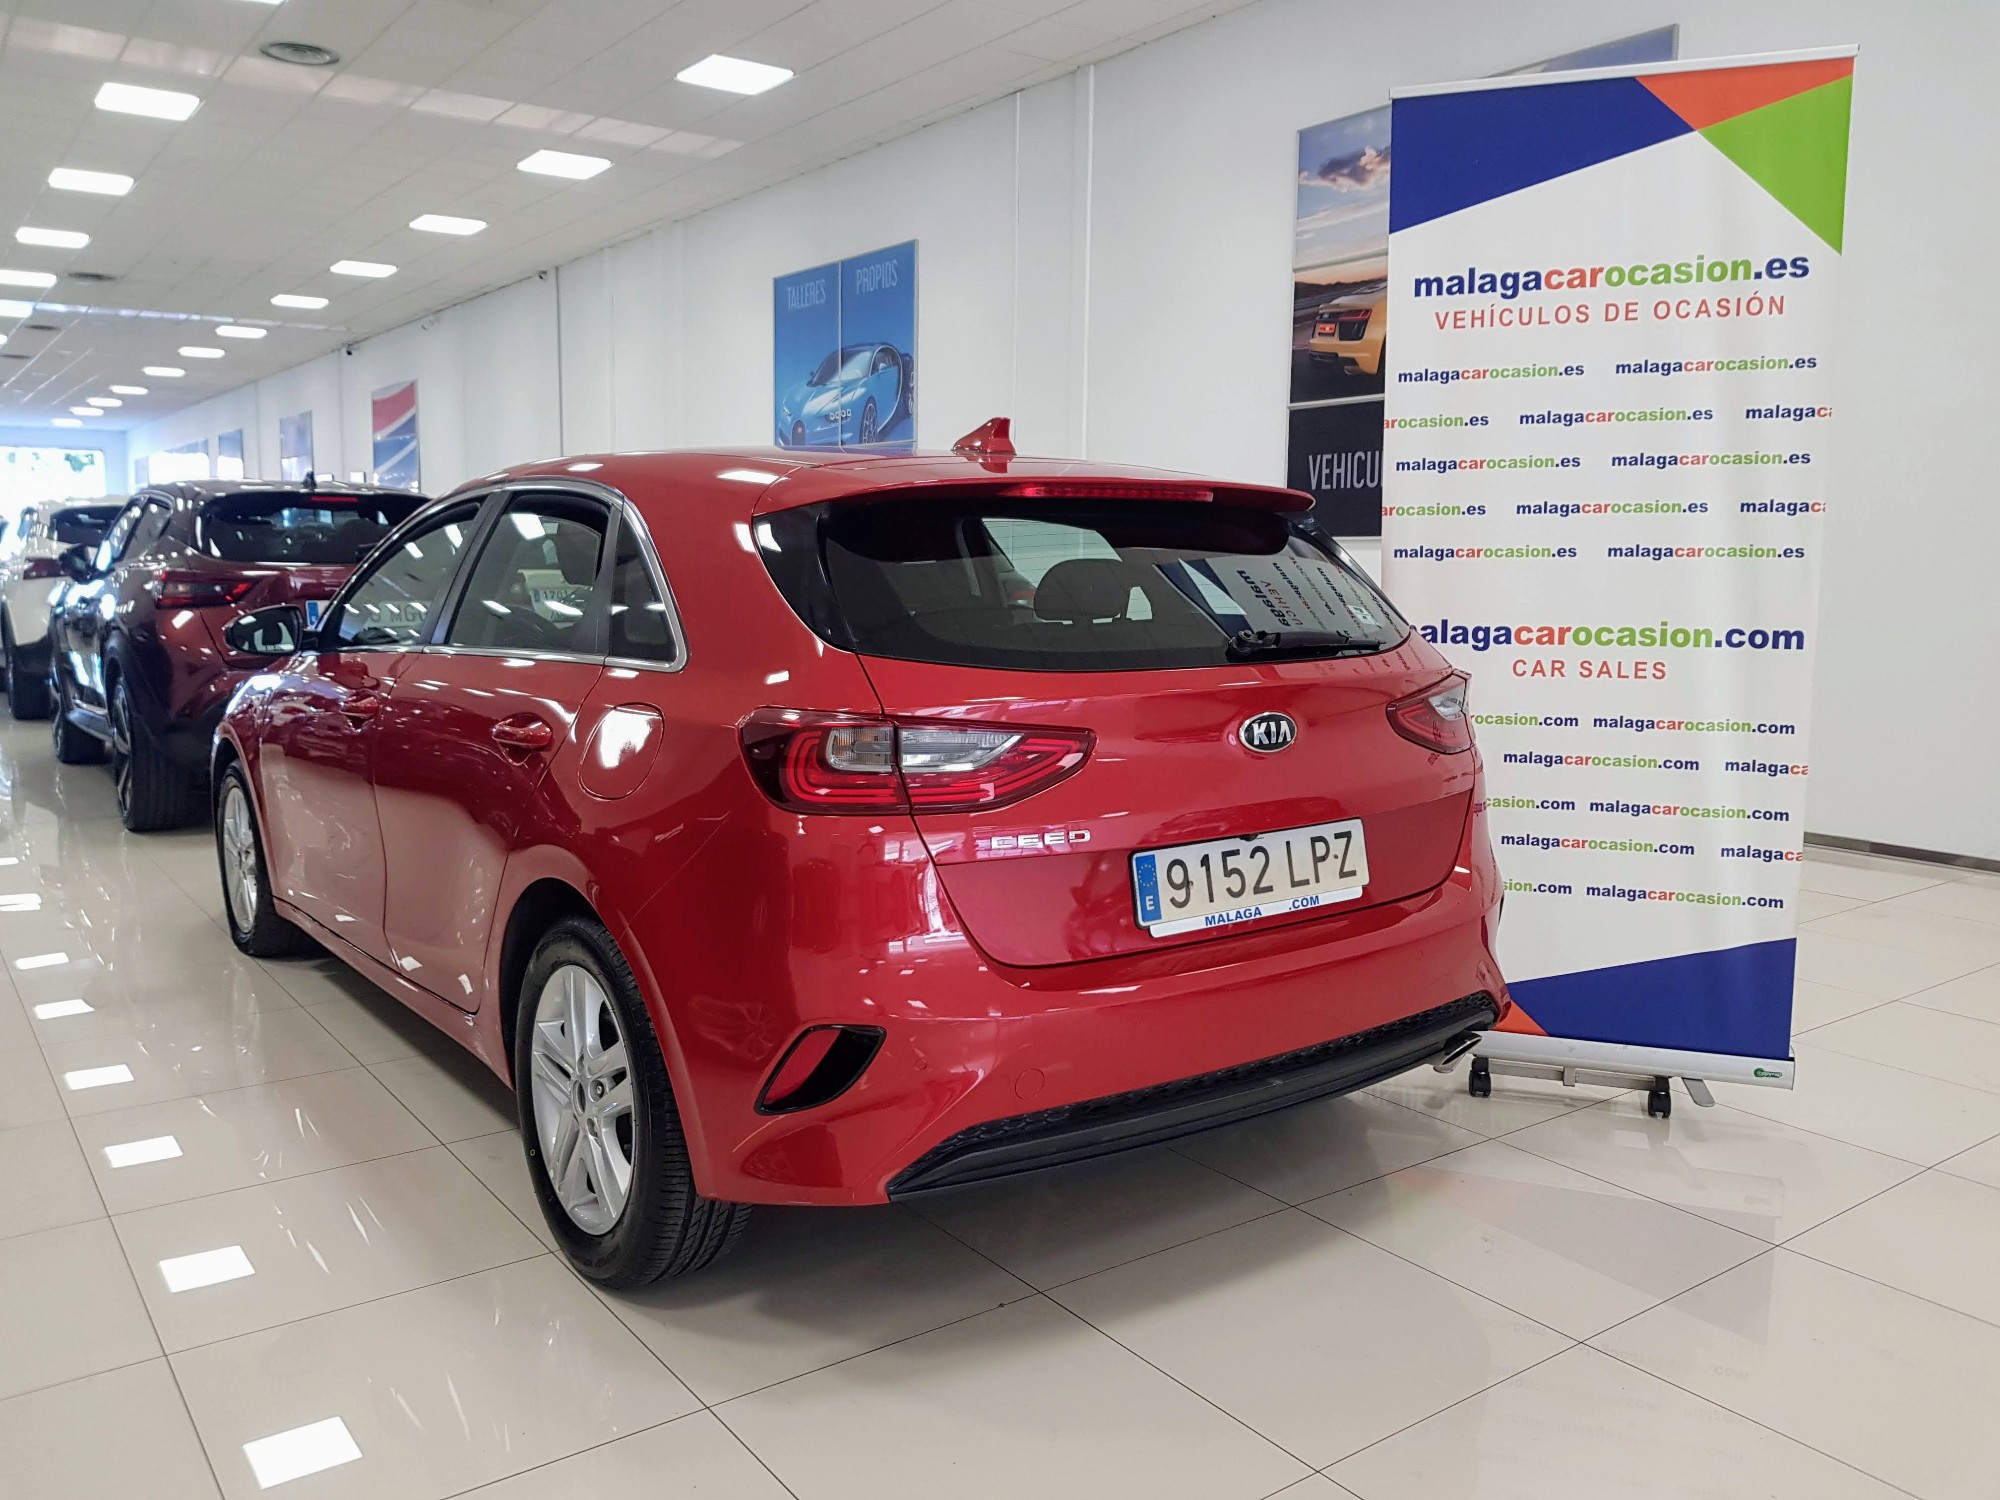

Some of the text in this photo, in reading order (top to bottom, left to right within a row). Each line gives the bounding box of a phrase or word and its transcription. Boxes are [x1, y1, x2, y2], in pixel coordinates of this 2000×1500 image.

[787, 259, 898, 310] TALLERES PROPIOS
[1414, 256, 1809, 299] malagacarocasion.es
[1435, 291, 1784, 329] VEHÍCULOS DE OCASIÓN
[1398, 356, 1817, 384] malagacarocasion.es malagacarocasion.es
[1520, 408, 1713, 427] malagacarocasion.es
[1309, 450, 1382, 491] VEHICU
[1396, 451, 1810, 473] malagacarocasion.es malagacarocasion.es
[1517, 500, 1708, 517] malagacarocasion.es
[1394, 544, 1804, 561] malagacarocasion.es malagacarocasion.es
[1410, 617, 1805, 651] alagacarocasion.com
[1512, 659, 1665, 679] CAR SALES
[1251, 719, 1292, 746] KIA
[1593, 716, 1795, 734] malagacarocasion.com
[1504, 751, 1699, 770] malagacarocasion.com
[1590, 800, 1789, 821] malagacarocasion.com
[1501, 834, 1694, 855] malagacarocasion.com
[1166, 830, 1357, 908] 9152 LPZ
[1146, 895, 1155, 911] E
[1587, 885, 1783, 908] malagacarocasion.com
[1204, 894, 1320, 927] MALAGA .COM
